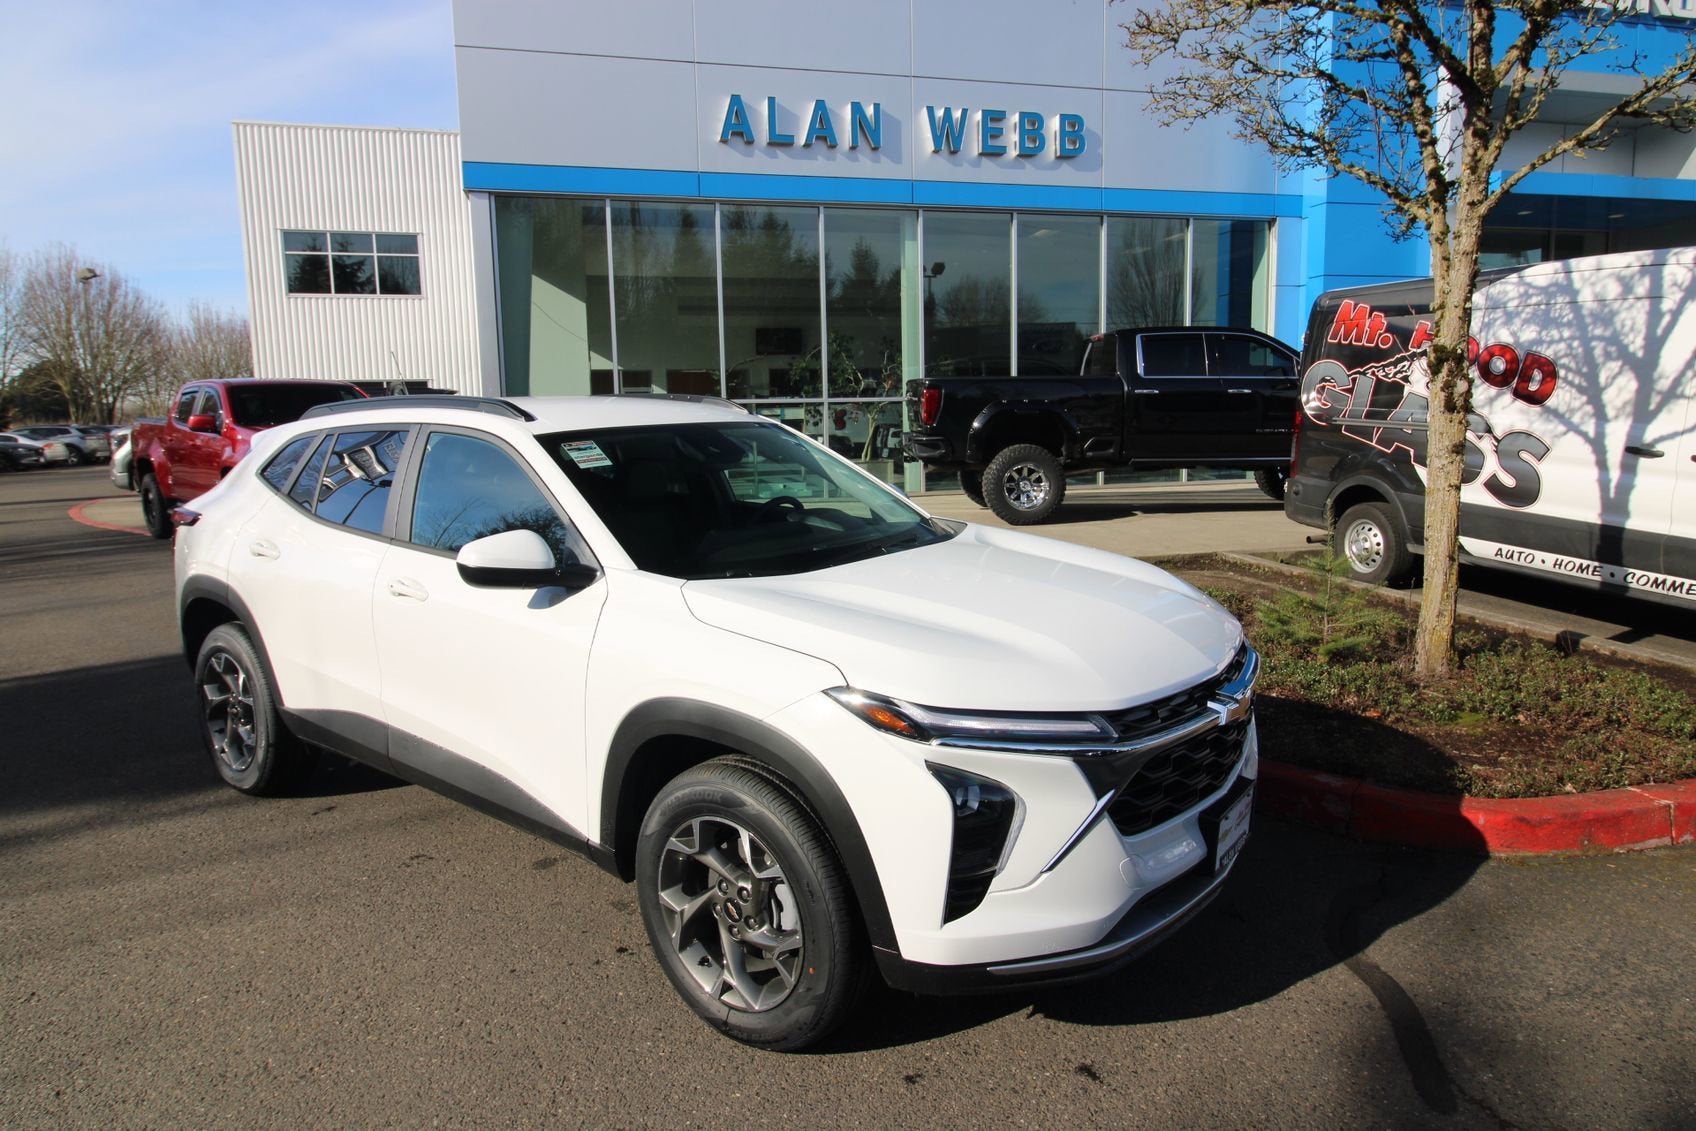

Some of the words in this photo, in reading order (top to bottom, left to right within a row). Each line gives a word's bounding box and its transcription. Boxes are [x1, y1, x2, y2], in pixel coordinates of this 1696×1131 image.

[719, 94, 881, 150] ALAN
[926, 105, 1087, 158] WEBB
[1328, 300, 1392, 348] Mt.
[1409, 320, 1558, 407] HOD
[1494, 547, 1536, 564] AUTO
[1552, 557, 1602, 577] HOME
